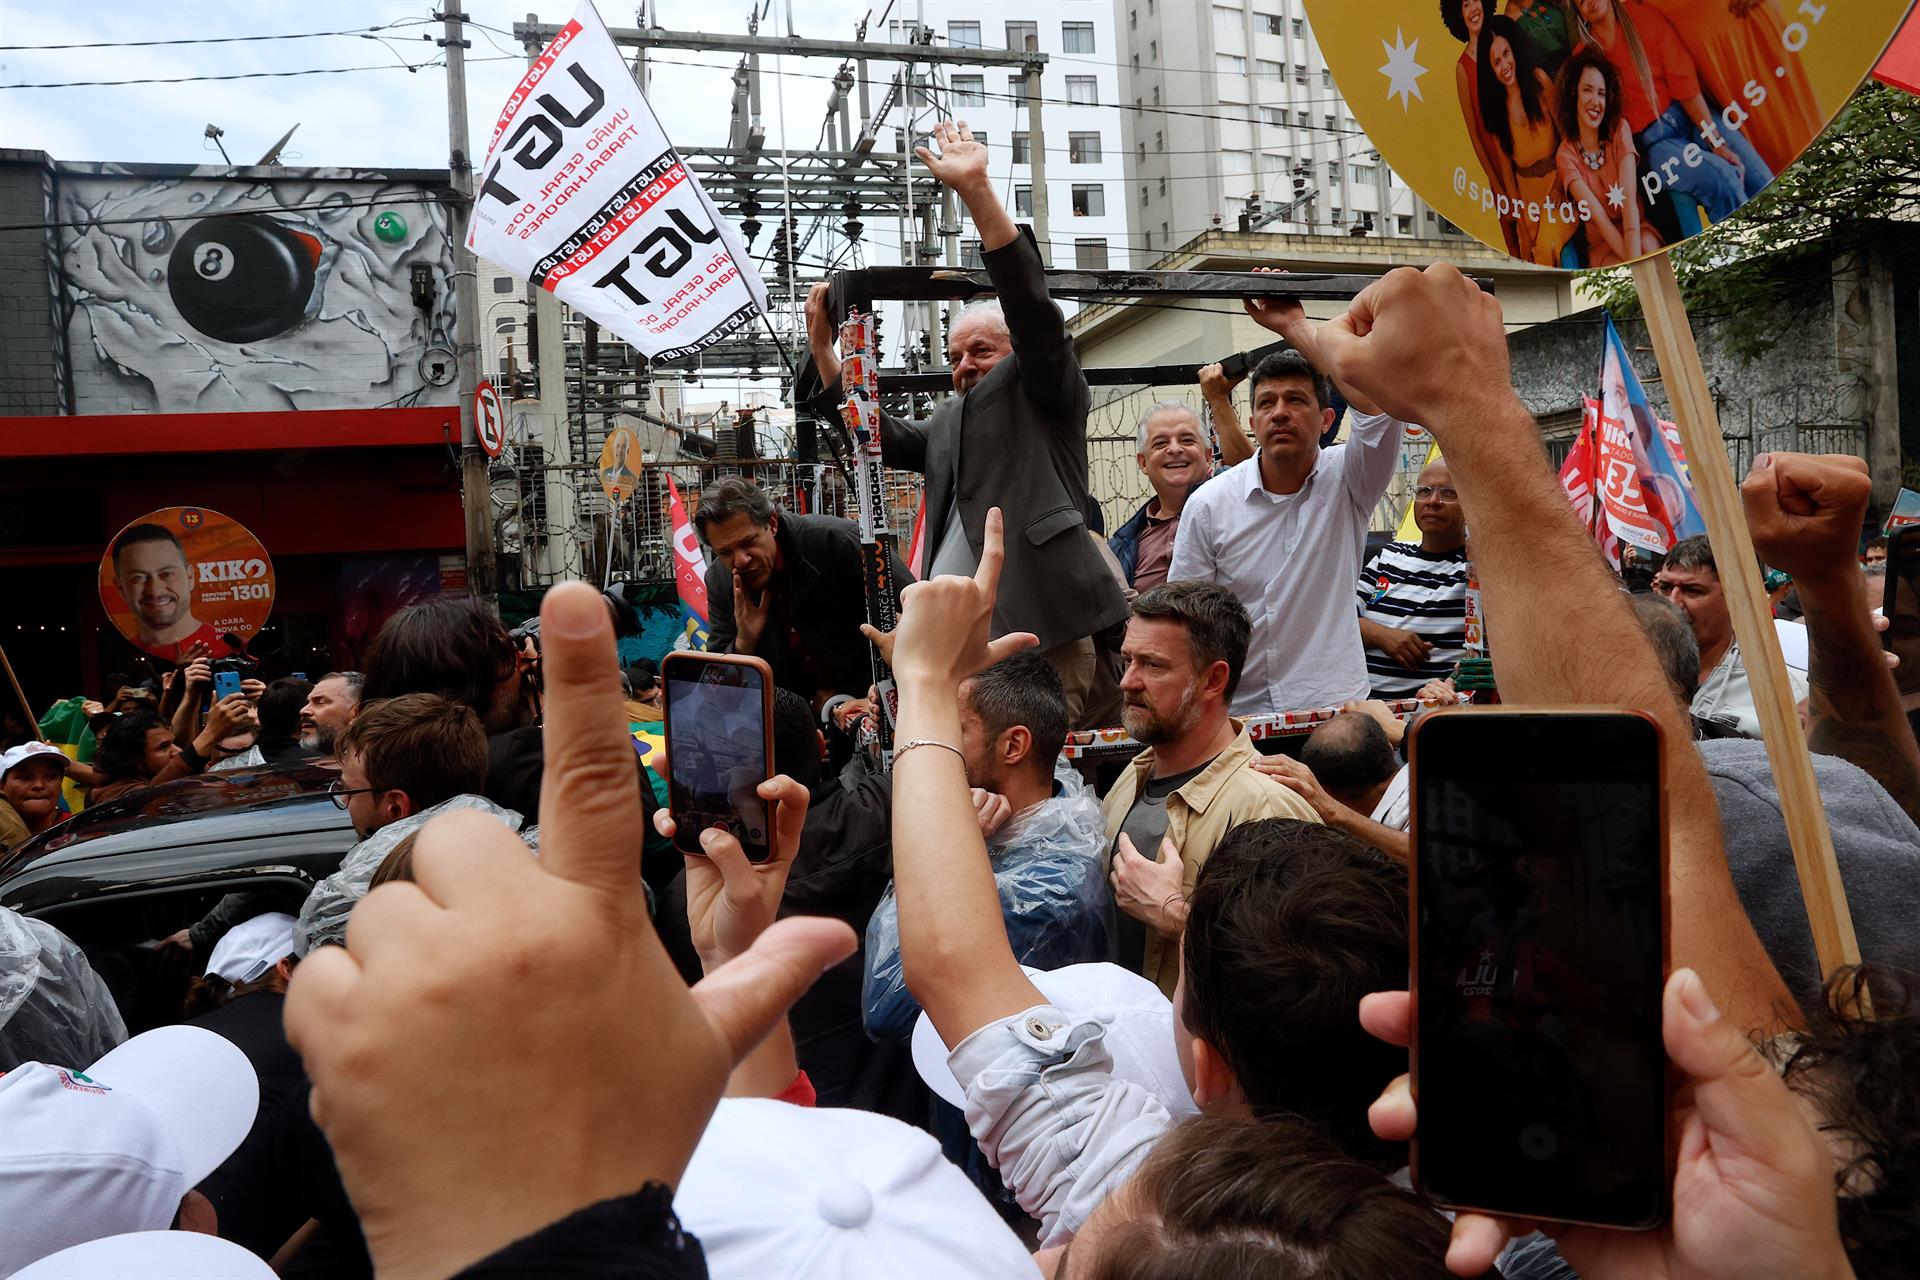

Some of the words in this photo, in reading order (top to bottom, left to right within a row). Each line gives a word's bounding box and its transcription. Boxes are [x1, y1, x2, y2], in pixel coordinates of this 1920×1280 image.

[1453, 166, 1592, 225] @sppretas
[200, 248, 223, 276] 8
[186, 514, 198, 523] 13
[197, 559, 267, 583] KIKO
[231, 583, 270, 601] 1301
[881, 588, 892, 631] RANÇA
[215, 625, 239, 633] NOVA
[222, 617, 245, 625] CARA
